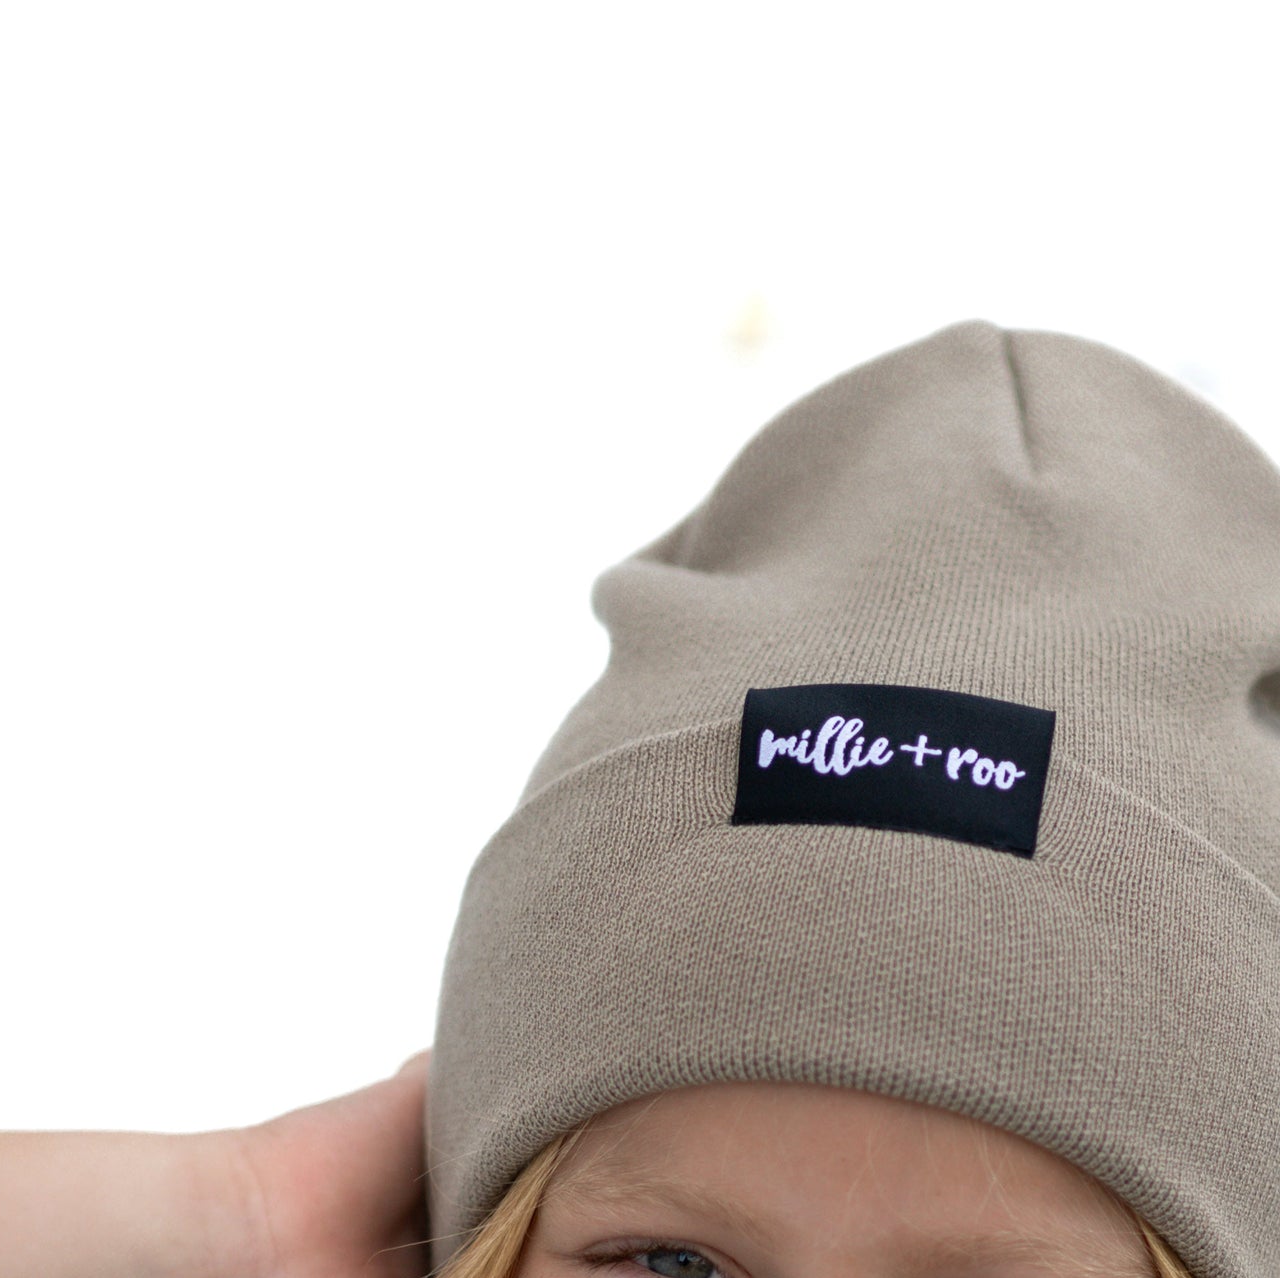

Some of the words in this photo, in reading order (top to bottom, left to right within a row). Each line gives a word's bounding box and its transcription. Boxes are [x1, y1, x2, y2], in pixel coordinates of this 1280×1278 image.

[758, 716, 894, 776] millie
[900, 734, 942, 766] +
[946, 746, 1026, 790] roo
